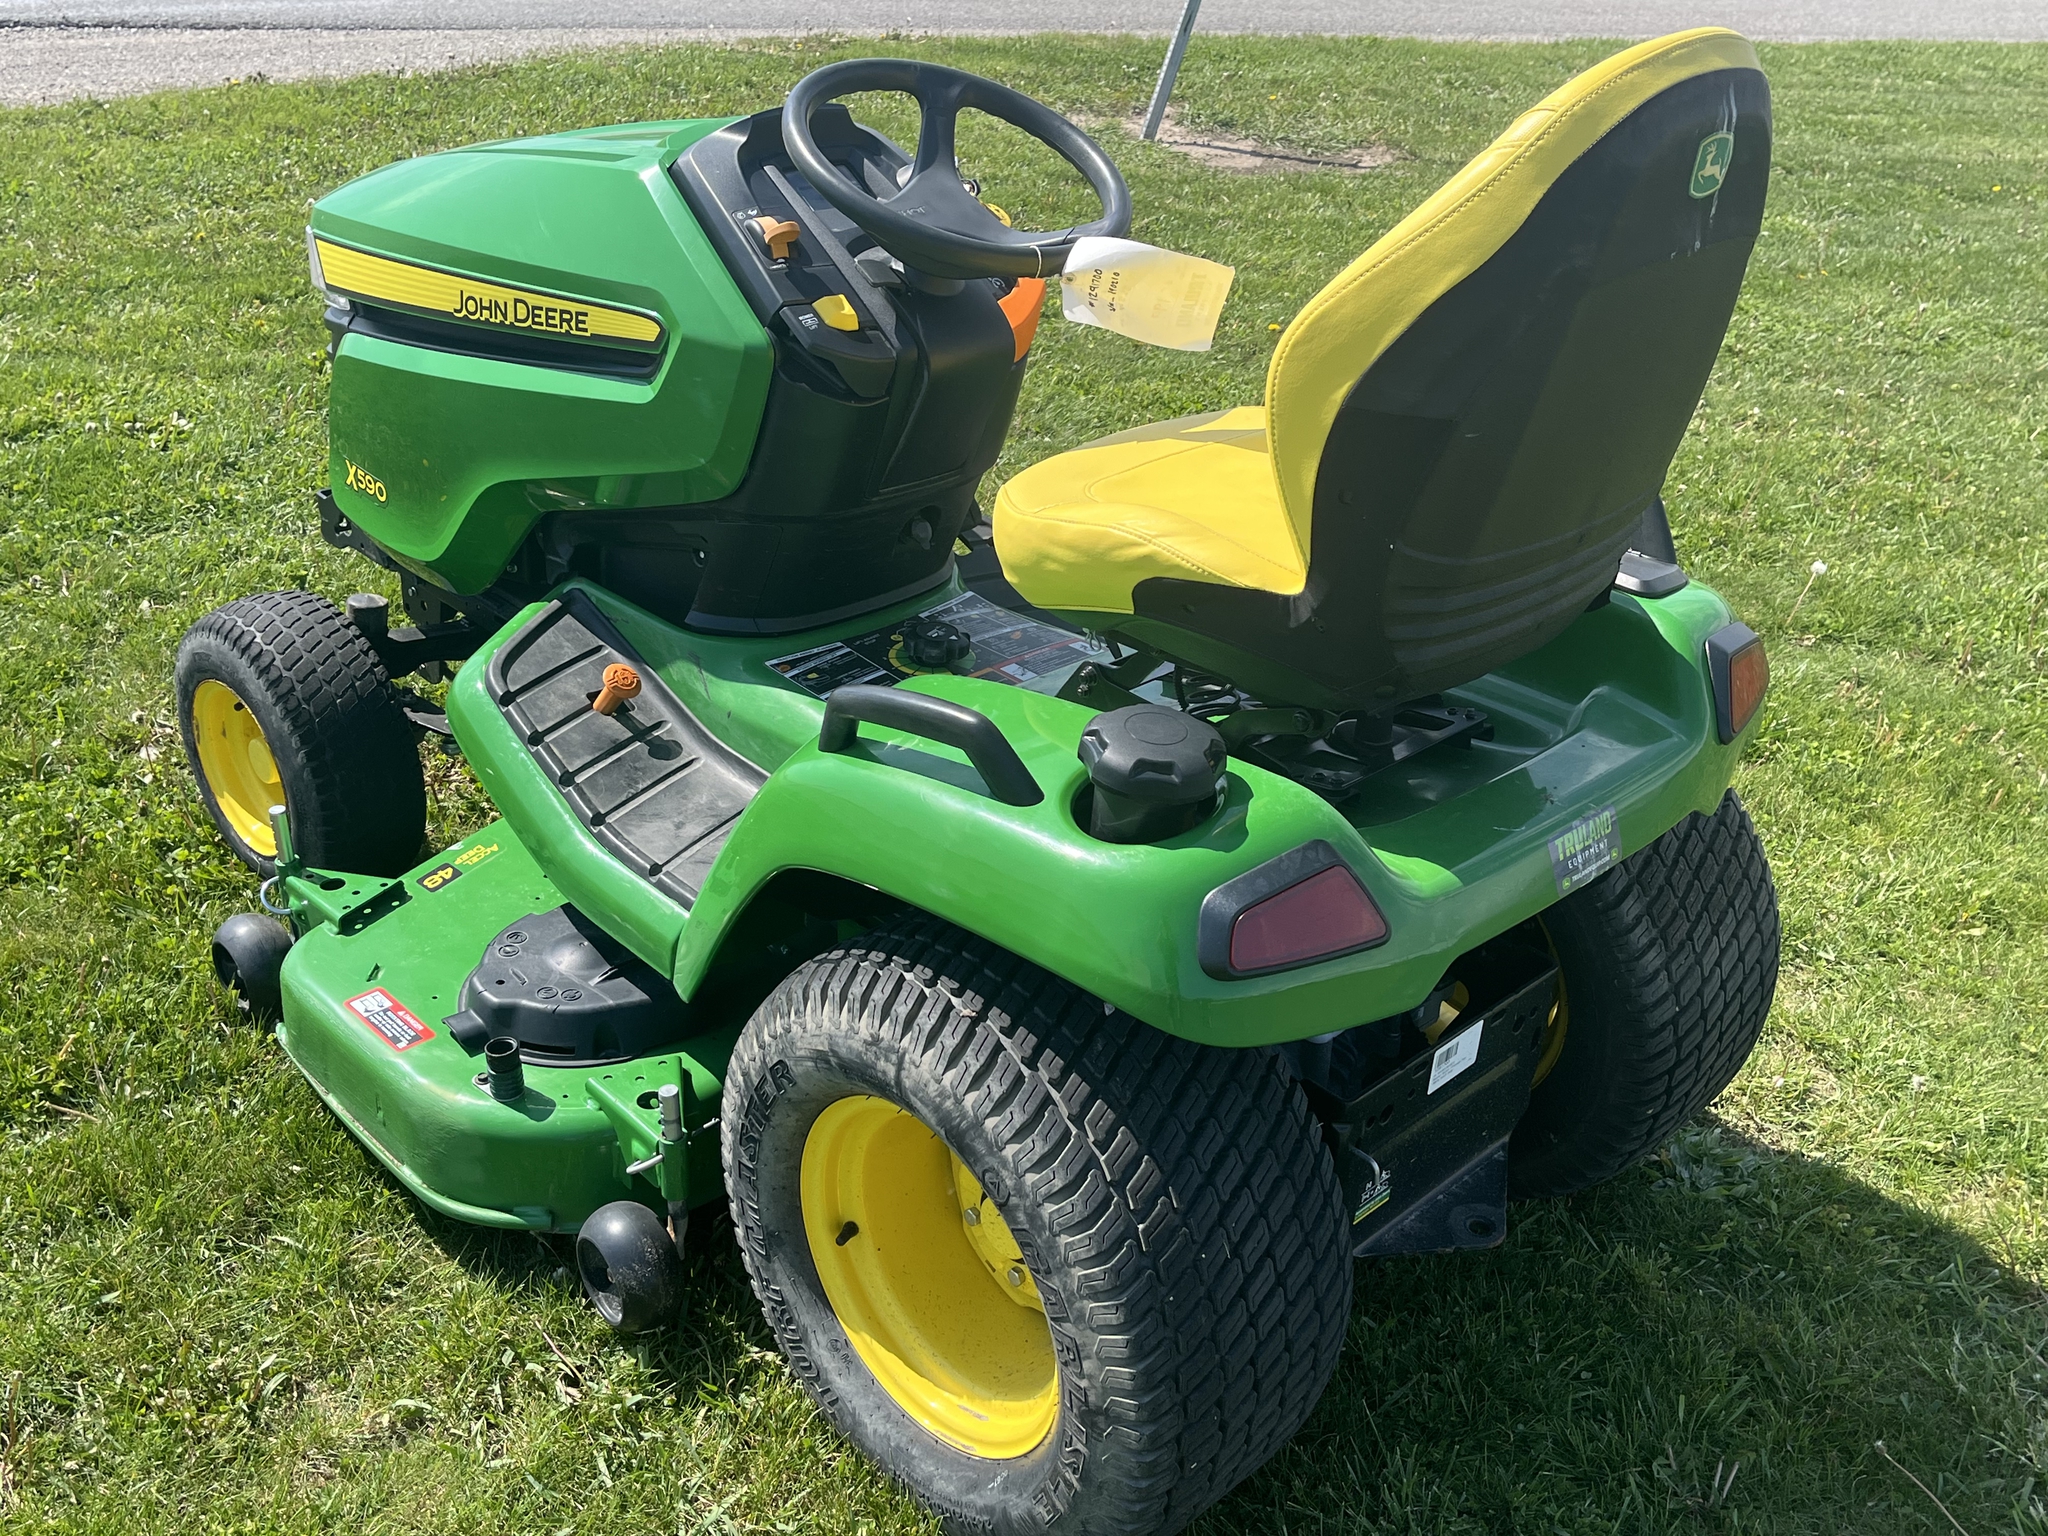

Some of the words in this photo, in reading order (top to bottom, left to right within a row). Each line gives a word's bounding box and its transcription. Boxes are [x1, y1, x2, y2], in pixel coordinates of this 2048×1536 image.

[453, 290, 508, 322] JOHN
[513, 298, 589, 333] DEERE
[345, 459, 387, 503] X590
[1554, 810, 1612, 862] TRULAND
[454, 844, 486, 865] DEEP
[463, 843, 499, 866] ACCEL
[1567, 839, 1608, 869] EQUIPMENT
[423, 866, 455, 889] 48
